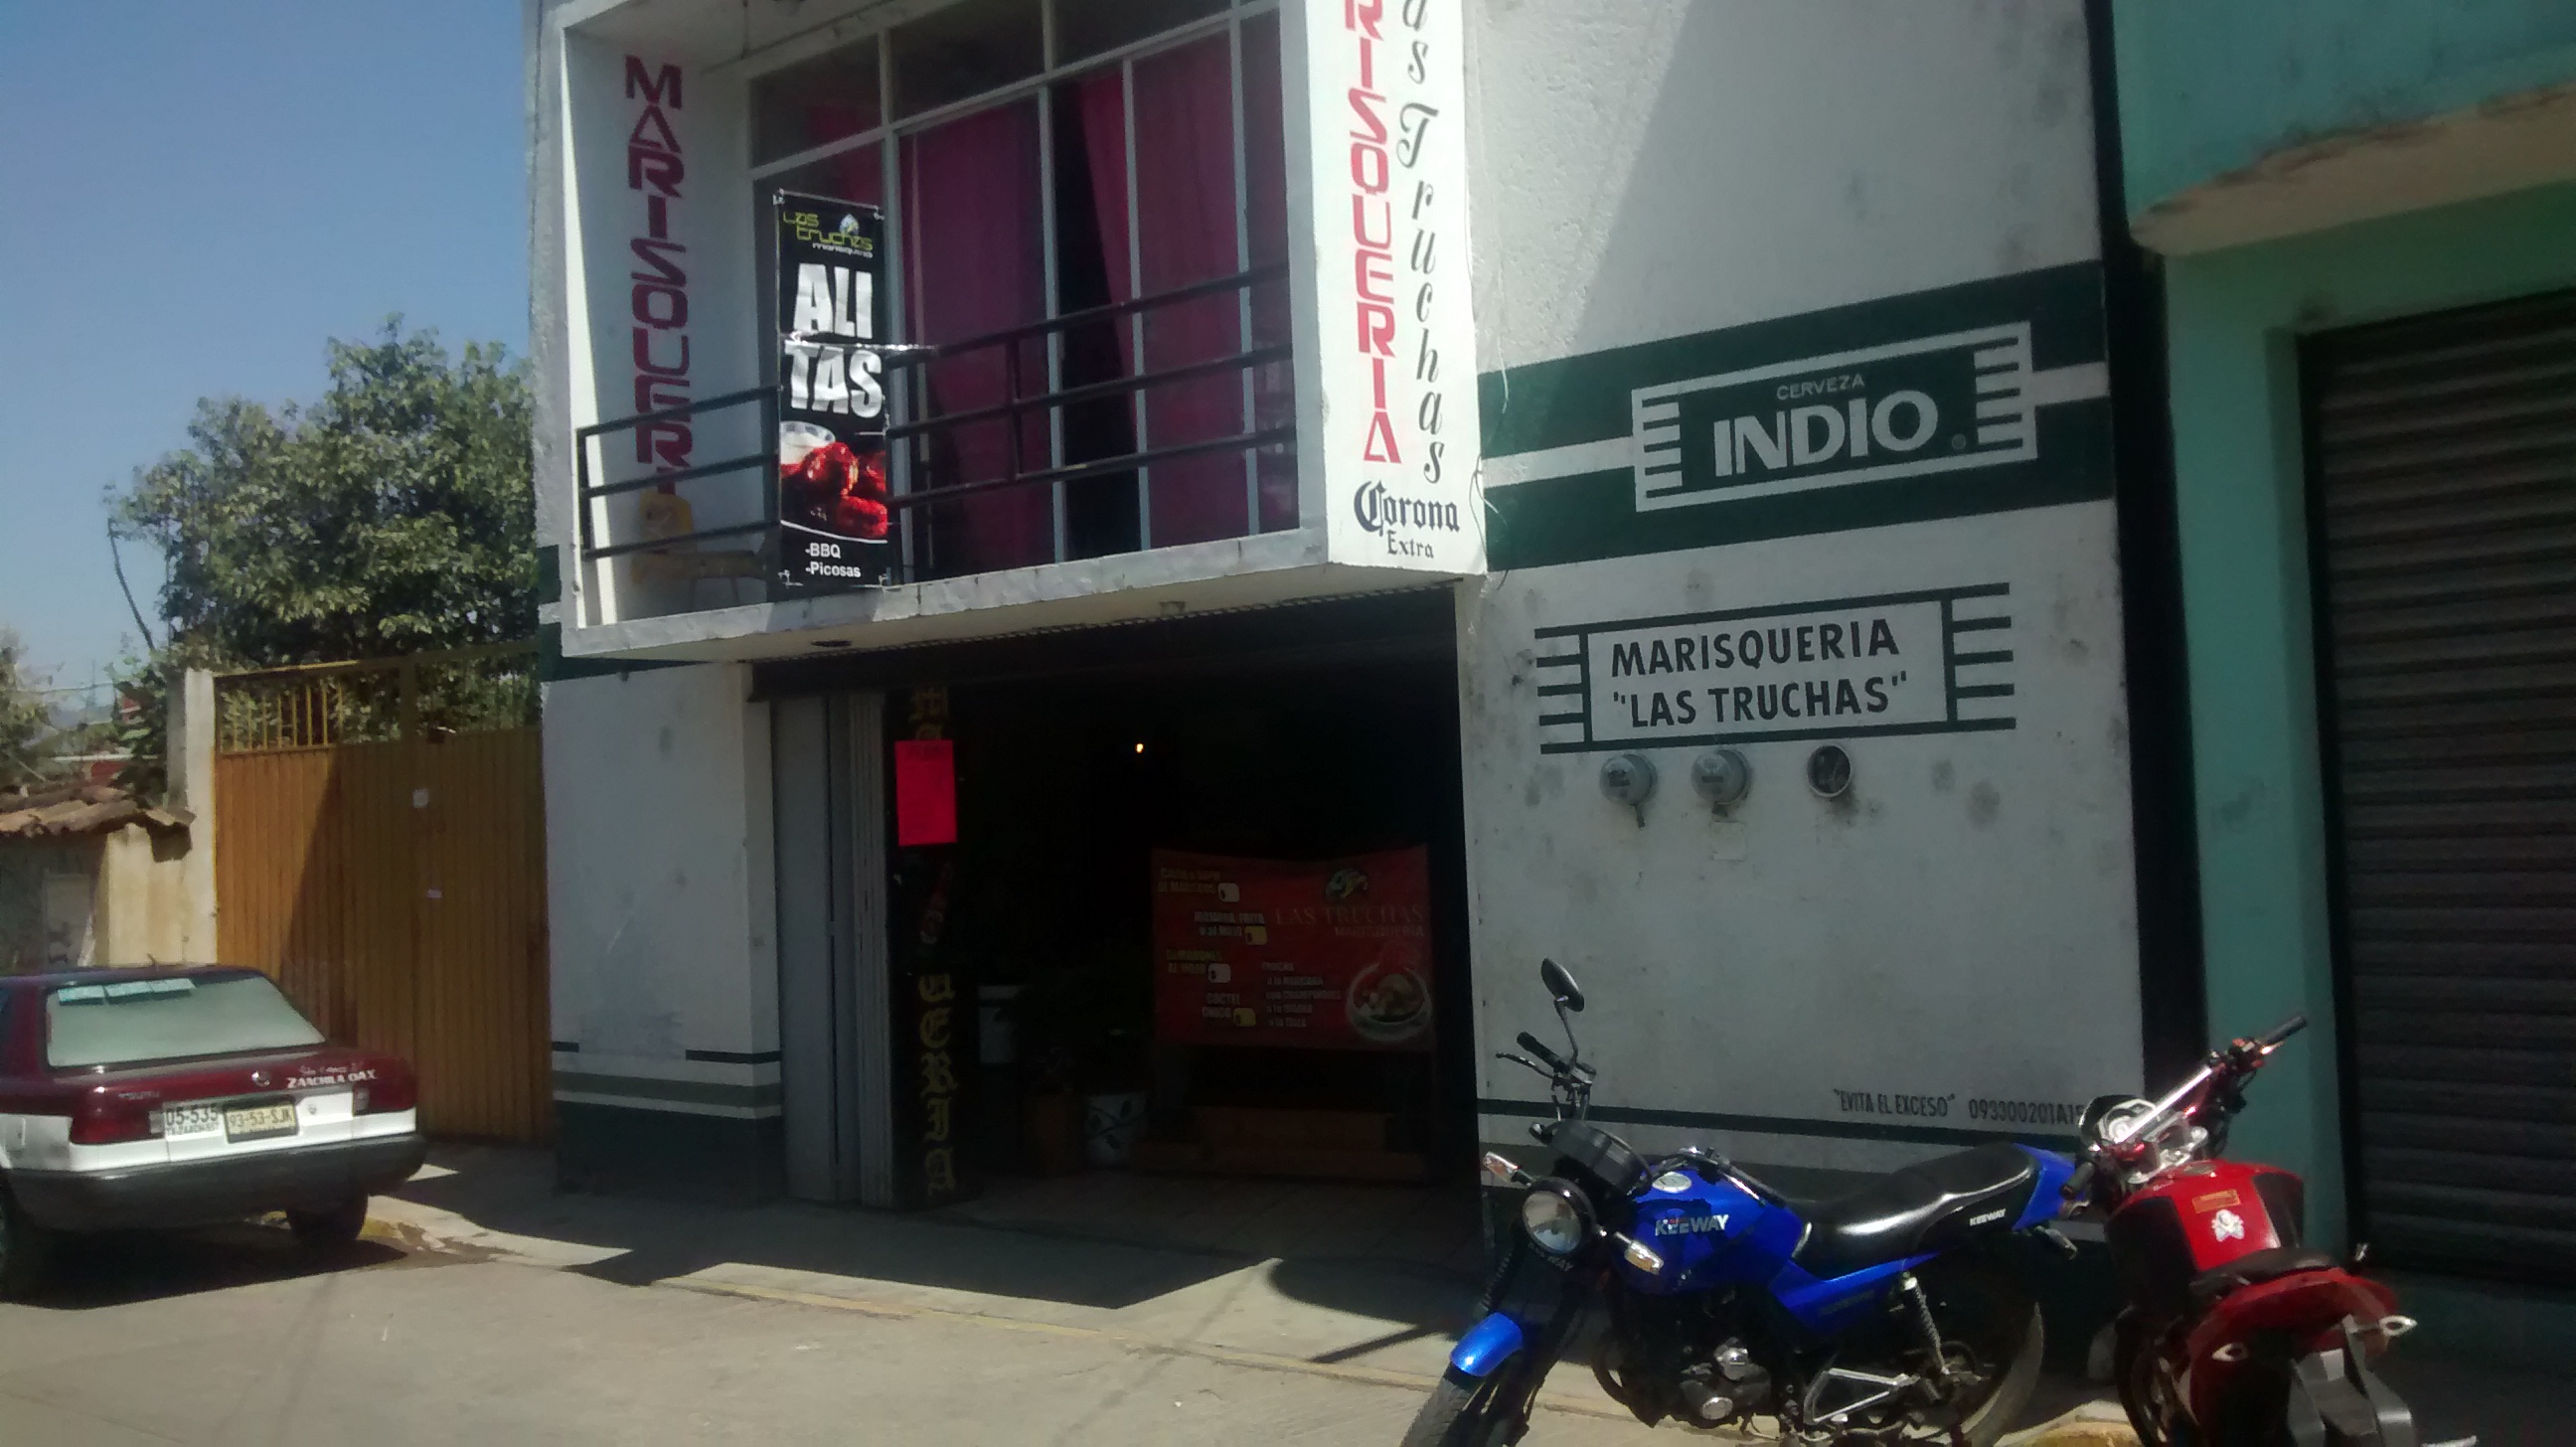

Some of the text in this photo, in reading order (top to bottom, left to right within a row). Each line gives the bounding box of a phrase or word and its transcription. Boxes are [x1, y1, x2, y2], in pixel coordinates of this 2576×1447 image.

[625, 55, 693, 496] MARISQUERI
[794, 262, 874, 339] ALI
[1396, 102, 1446, 484] Truchas
[784, 340, 884, 418] TAS
[1776, 373, 1865, 401] CERVEZA
[1713, 390, 1939, 478] INDIO
[1354, 480, 1460, 537] Corona
[1386, 530, 1434, 559] Extra
[1612, 618, 1900, 678] MARISQUERIA
[1613, 670, 1908, 727] "LAS TRUCHAS"
[1877, 1094, 1892, 1114] EL
[1655, 1213, 1729, 1236] KEEWAY
